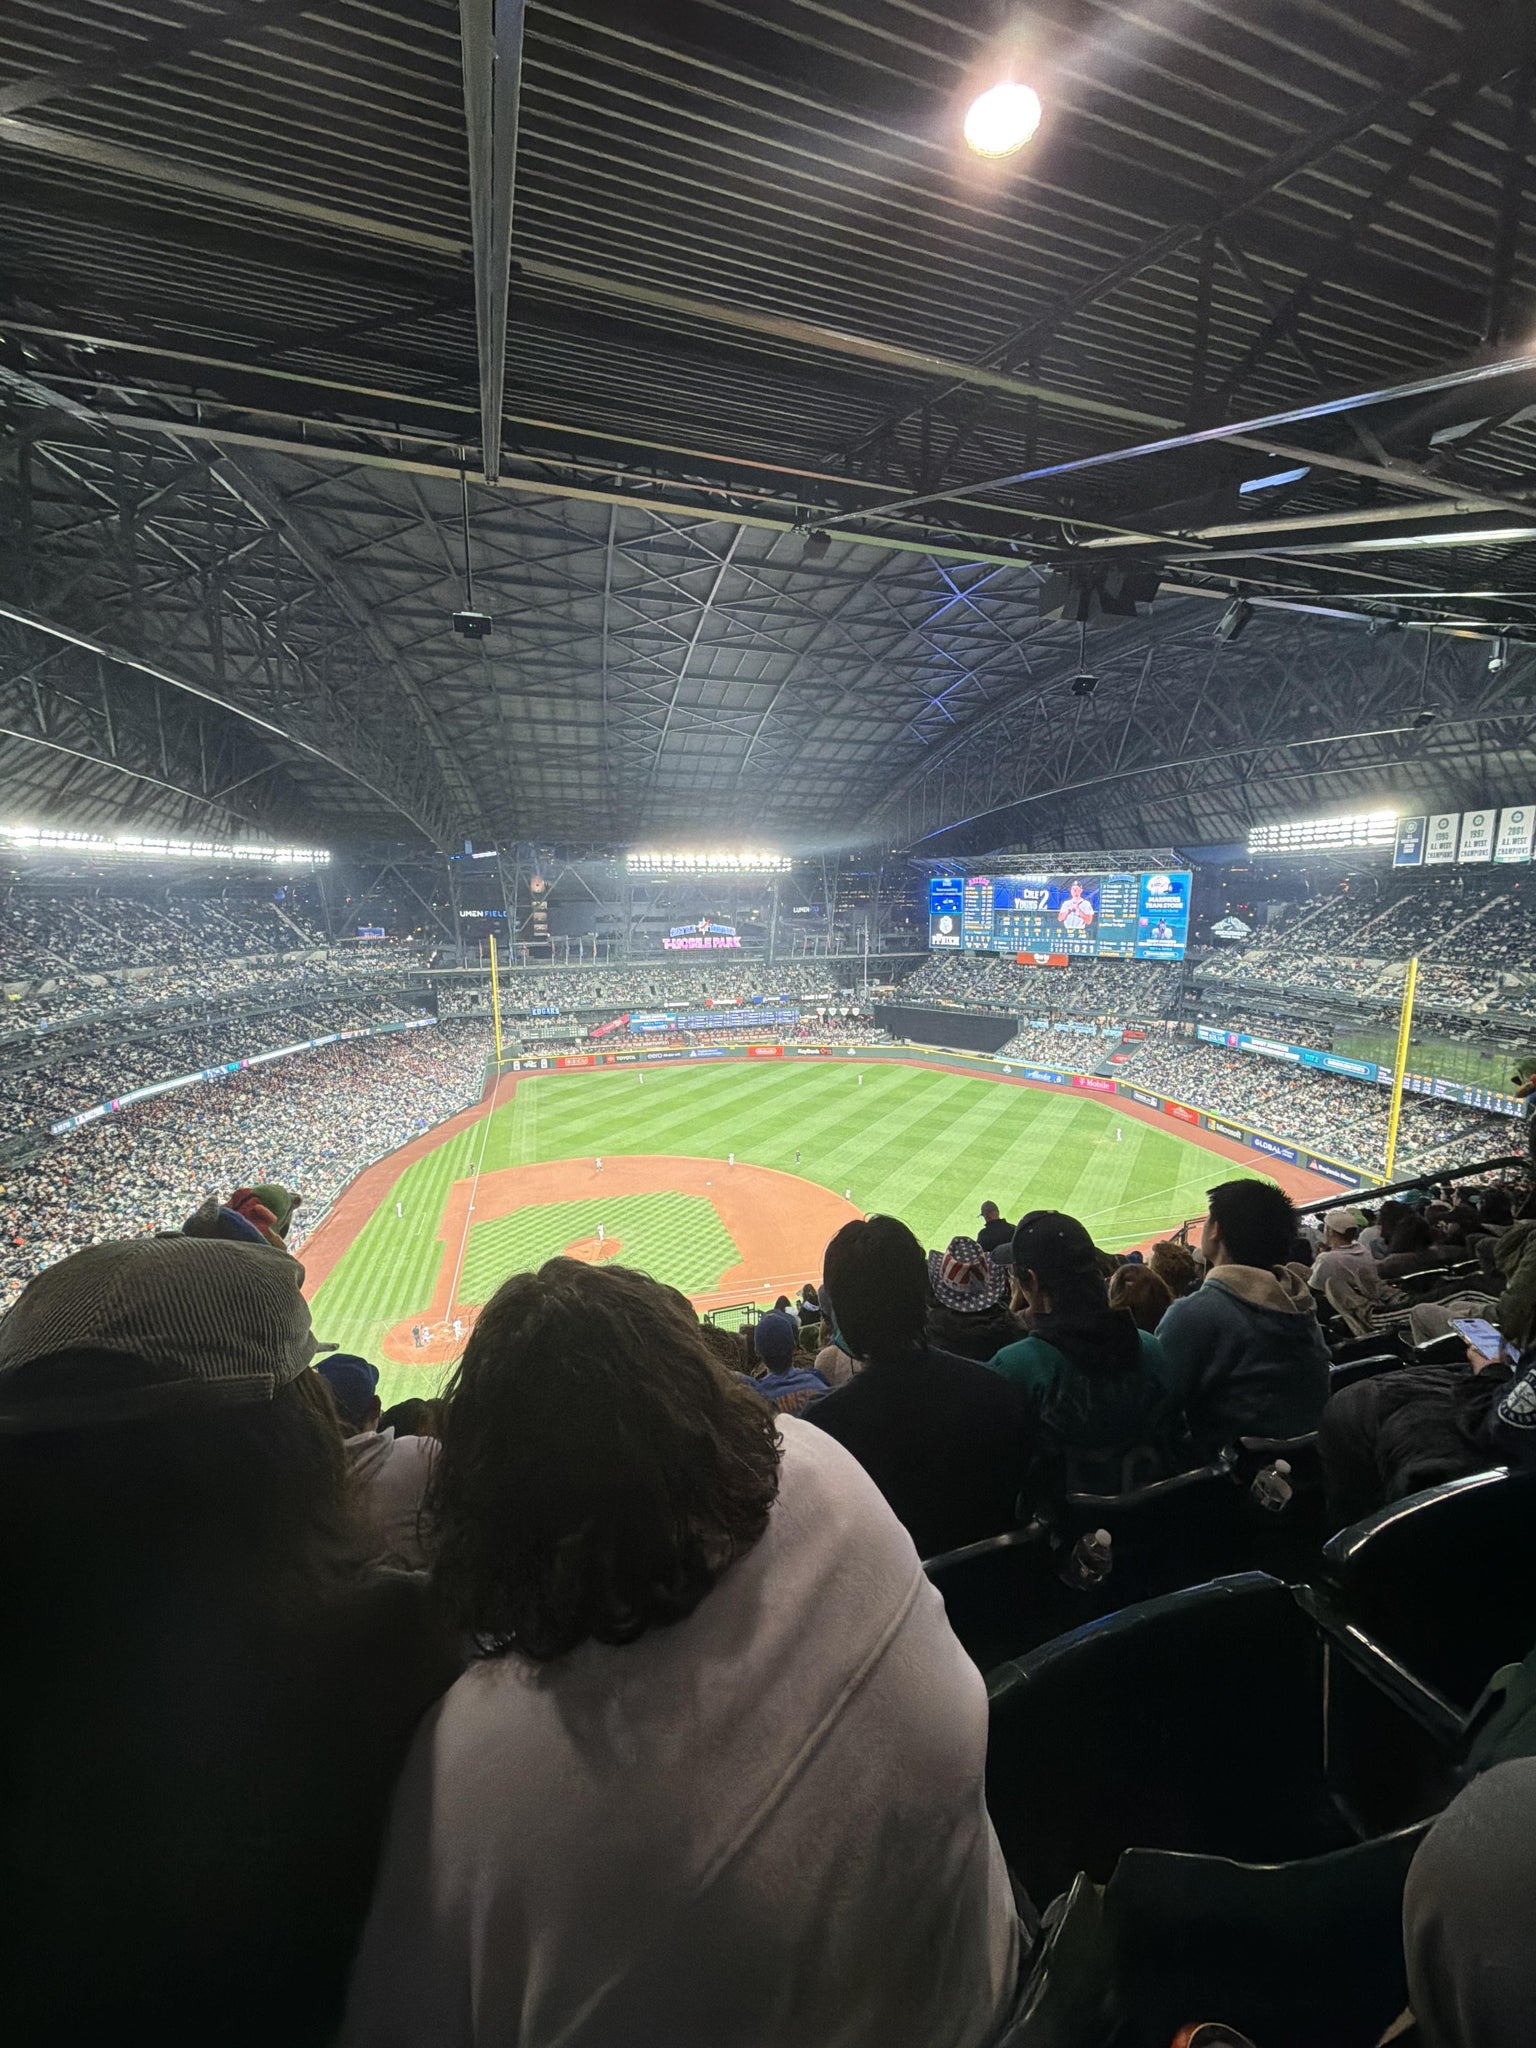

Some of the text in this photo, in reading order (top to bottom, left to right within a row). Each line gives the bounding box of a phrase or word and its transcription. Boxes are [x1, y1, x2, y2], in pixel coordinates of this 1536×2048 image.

[1470, 830, 1485, 838] 1997
[1473, 839, 1487, 847] WEST
[1512, 837, 1527, 845] WEST
[1427, 851, 1454, 859] CHAMPIONS
[1460, 849, 1489, 857] CHAMPIONS
[1497, 847, 1529, 856] CHAMPIONS
[459, 910, 484, 918] UMEN
[662, 936, 742, 950] T-MOBILE PARK
[1216, 1122, 1242, 1140] Microsoft
[1254, 1138, 1282, 1155] GLOBAL
